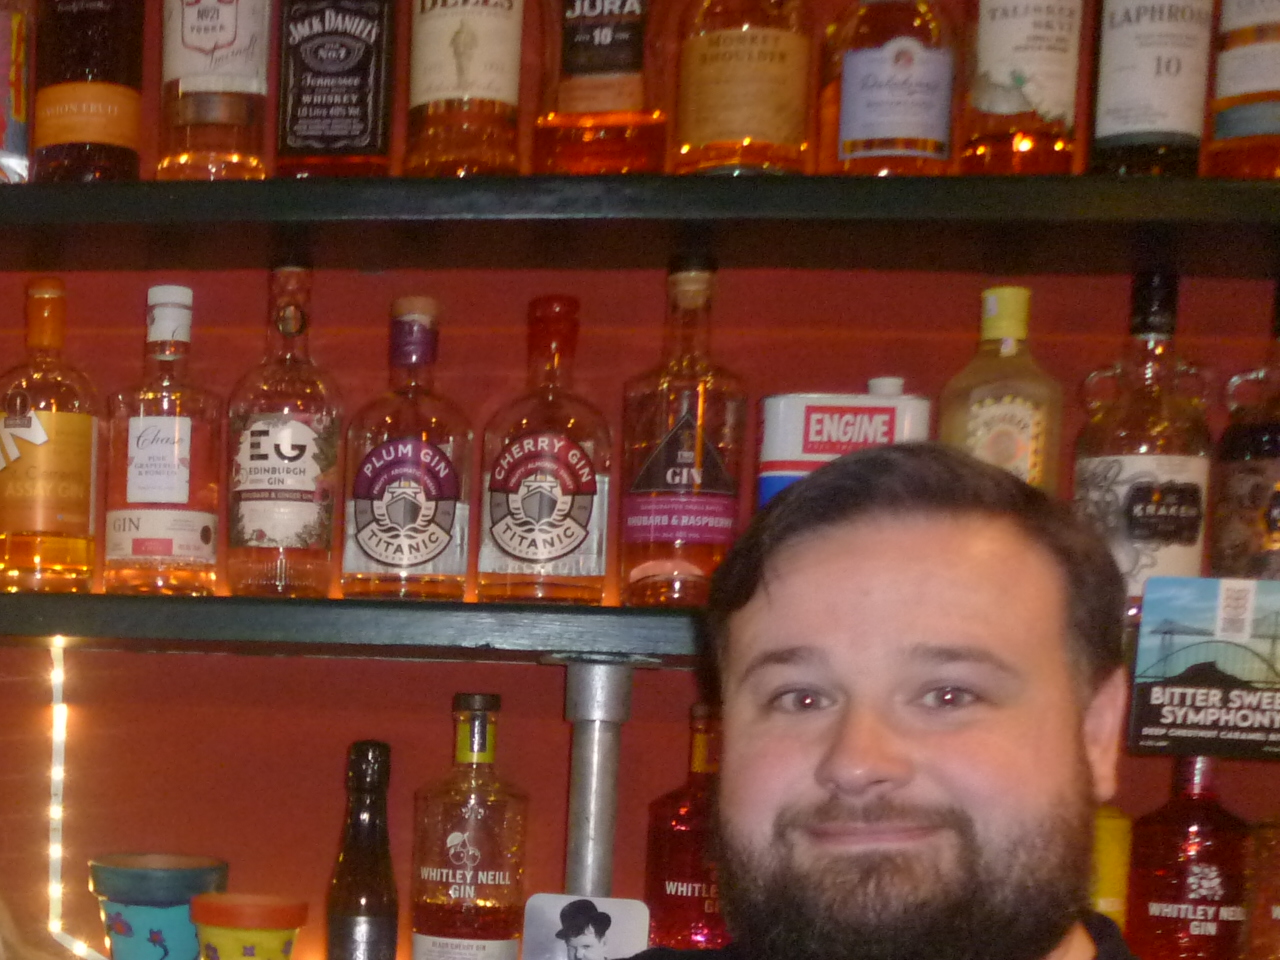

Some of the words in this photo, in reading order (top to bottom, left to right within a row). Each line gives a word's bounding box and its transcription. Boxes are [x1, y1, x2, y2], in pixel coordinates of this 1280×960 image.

[566, 0, 641, 18] JURA
[593, 26, 612, 46] 10
[1154, 56, 1182, 77] 10
[809, 413, 889, 444] ENGINE
[363, 444, 412, 477] PLUM
[421, 449, 449, 478] GIN
[494, 437, 564, 480] CHERRY
[568, 449, 592, 482] GIN
[249, 467, 306, 476] EDINBURGH
[665, 467, 704, 485] GIN
[267, 477, 285, 486] GIN
[113, 517, 141, 532] GIN
[368, 529, 439, 555] TITANIC
[502, 523, 575, 550] TITANIC
[1150, 686, 1223, 707] BITTER
[420, 867, 473, 884] WHITLEY
[477, 871, 511, 885] NEILL
[450, 885, 475, 898] GIN
[1148, 902, 1217, 920] WHITLEY
[1189, 922, 1217, 936] GIN
